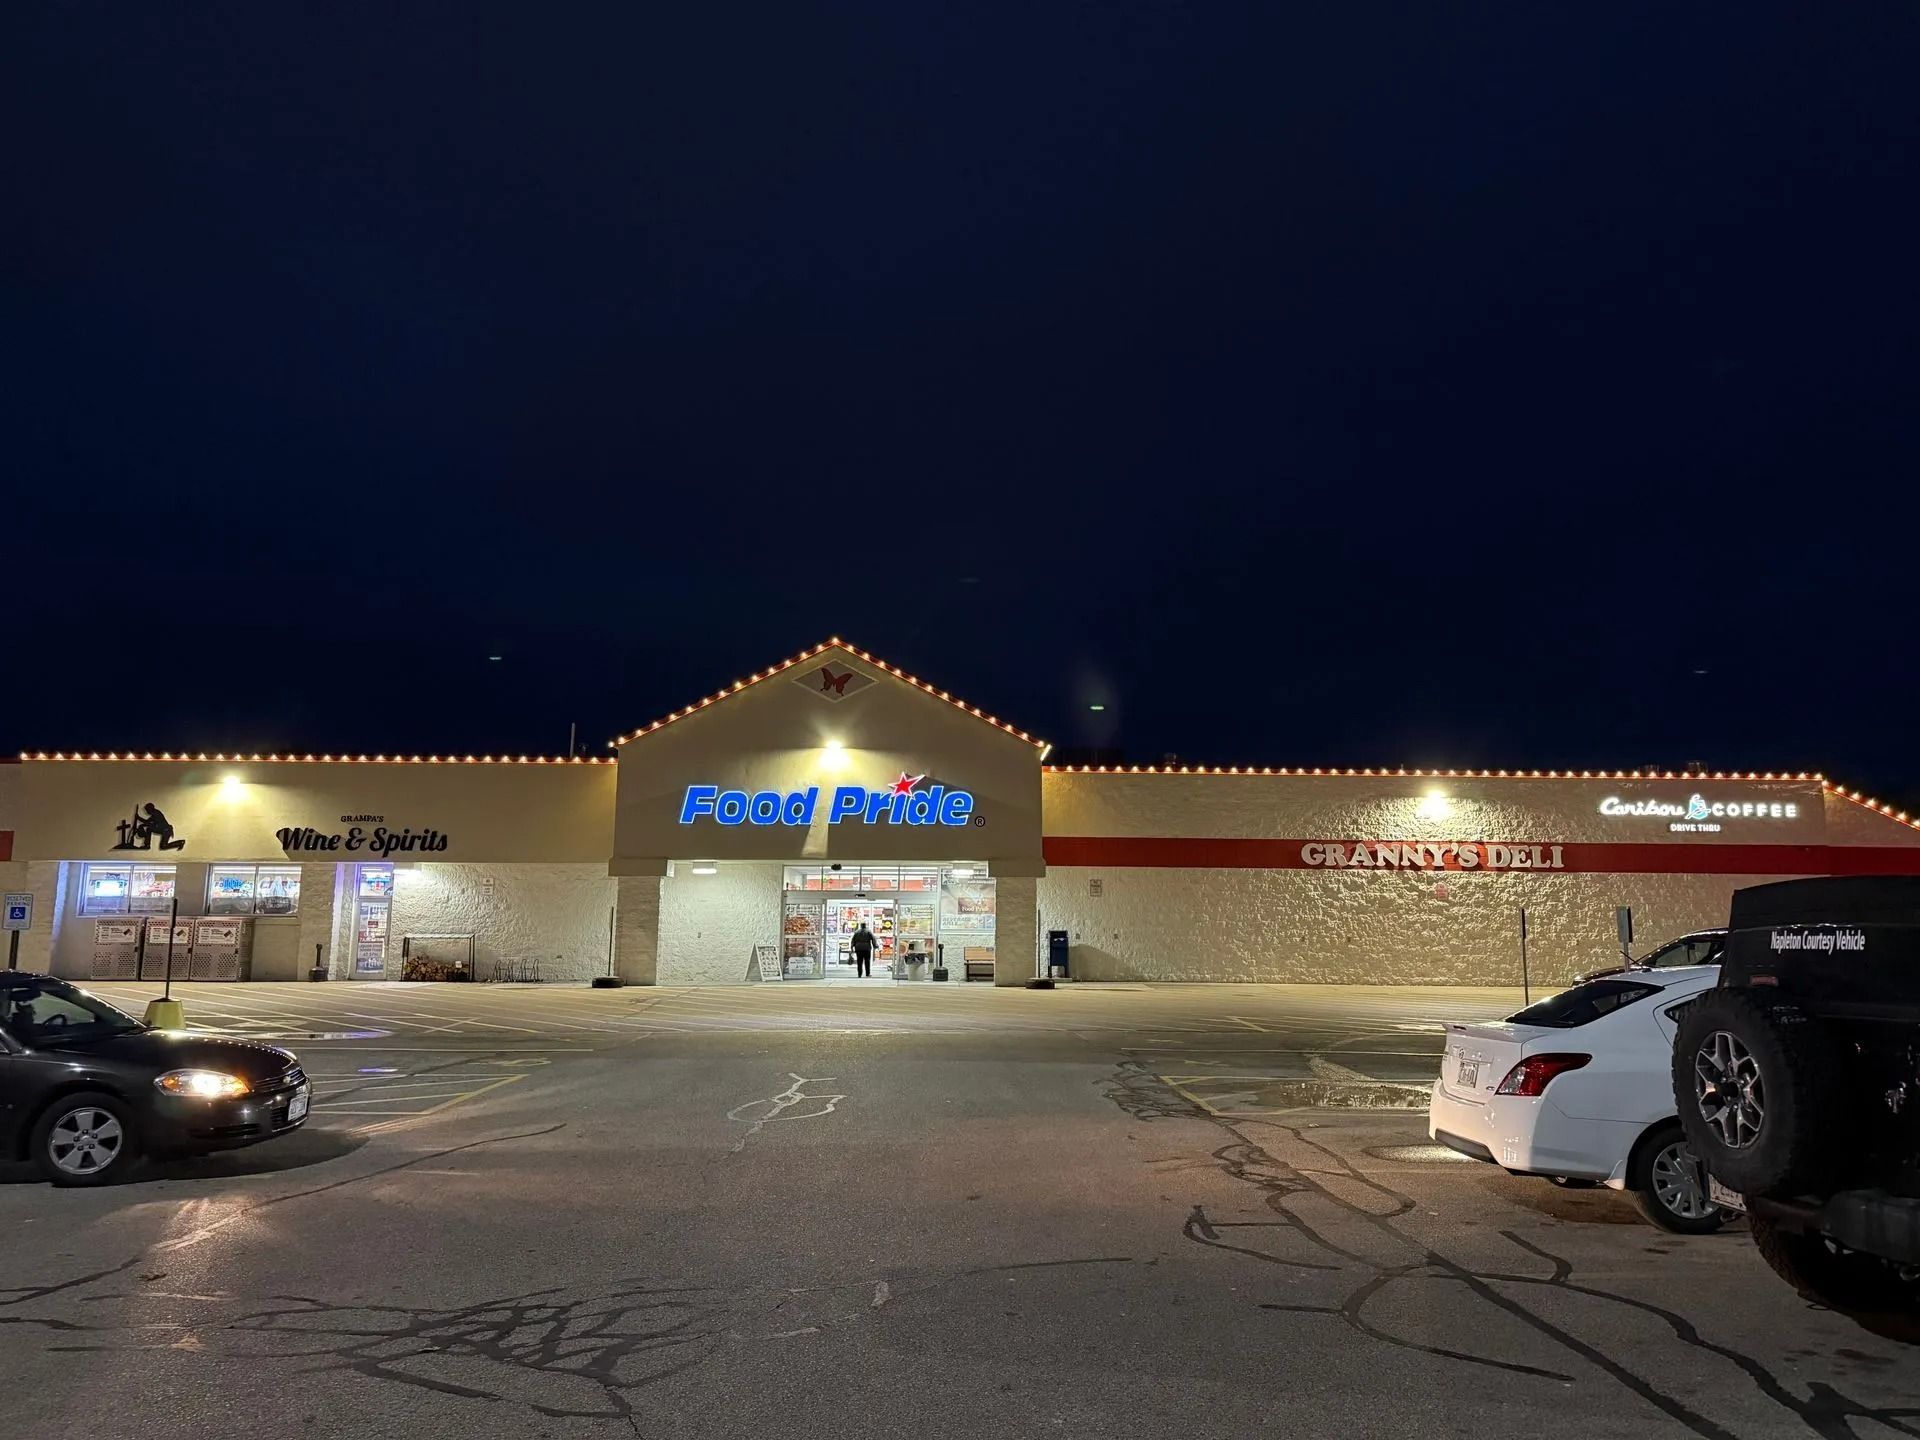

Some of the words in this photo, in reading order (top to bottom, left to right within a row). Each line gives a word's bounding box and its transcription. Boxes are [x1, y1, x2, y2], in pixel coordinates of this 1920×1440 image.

[680, 785, 820, 825] Food
[828, 773, 973, 825] Pride
[1600, 796, 1685, 816] Caribou
[1711, 803, 1797, 817] COFFEE
[1670, 824, 1696, 832] DRIVE
[1698, 824, 1721, 832] THRU
[276, 827, 341, 851] Wine
[345, 827, 367, 851] &
[369, 827, 448, 858] Spirits
[1301, 843, 1480, 868] GRANNY'S
[1487, 845, 1564, 868] DELI
[1770, 930, 1801, 954] Napleton
[1802, 930, 1835, 955] Courtesy
[1836, 929, 1865, 950] Vehicle
